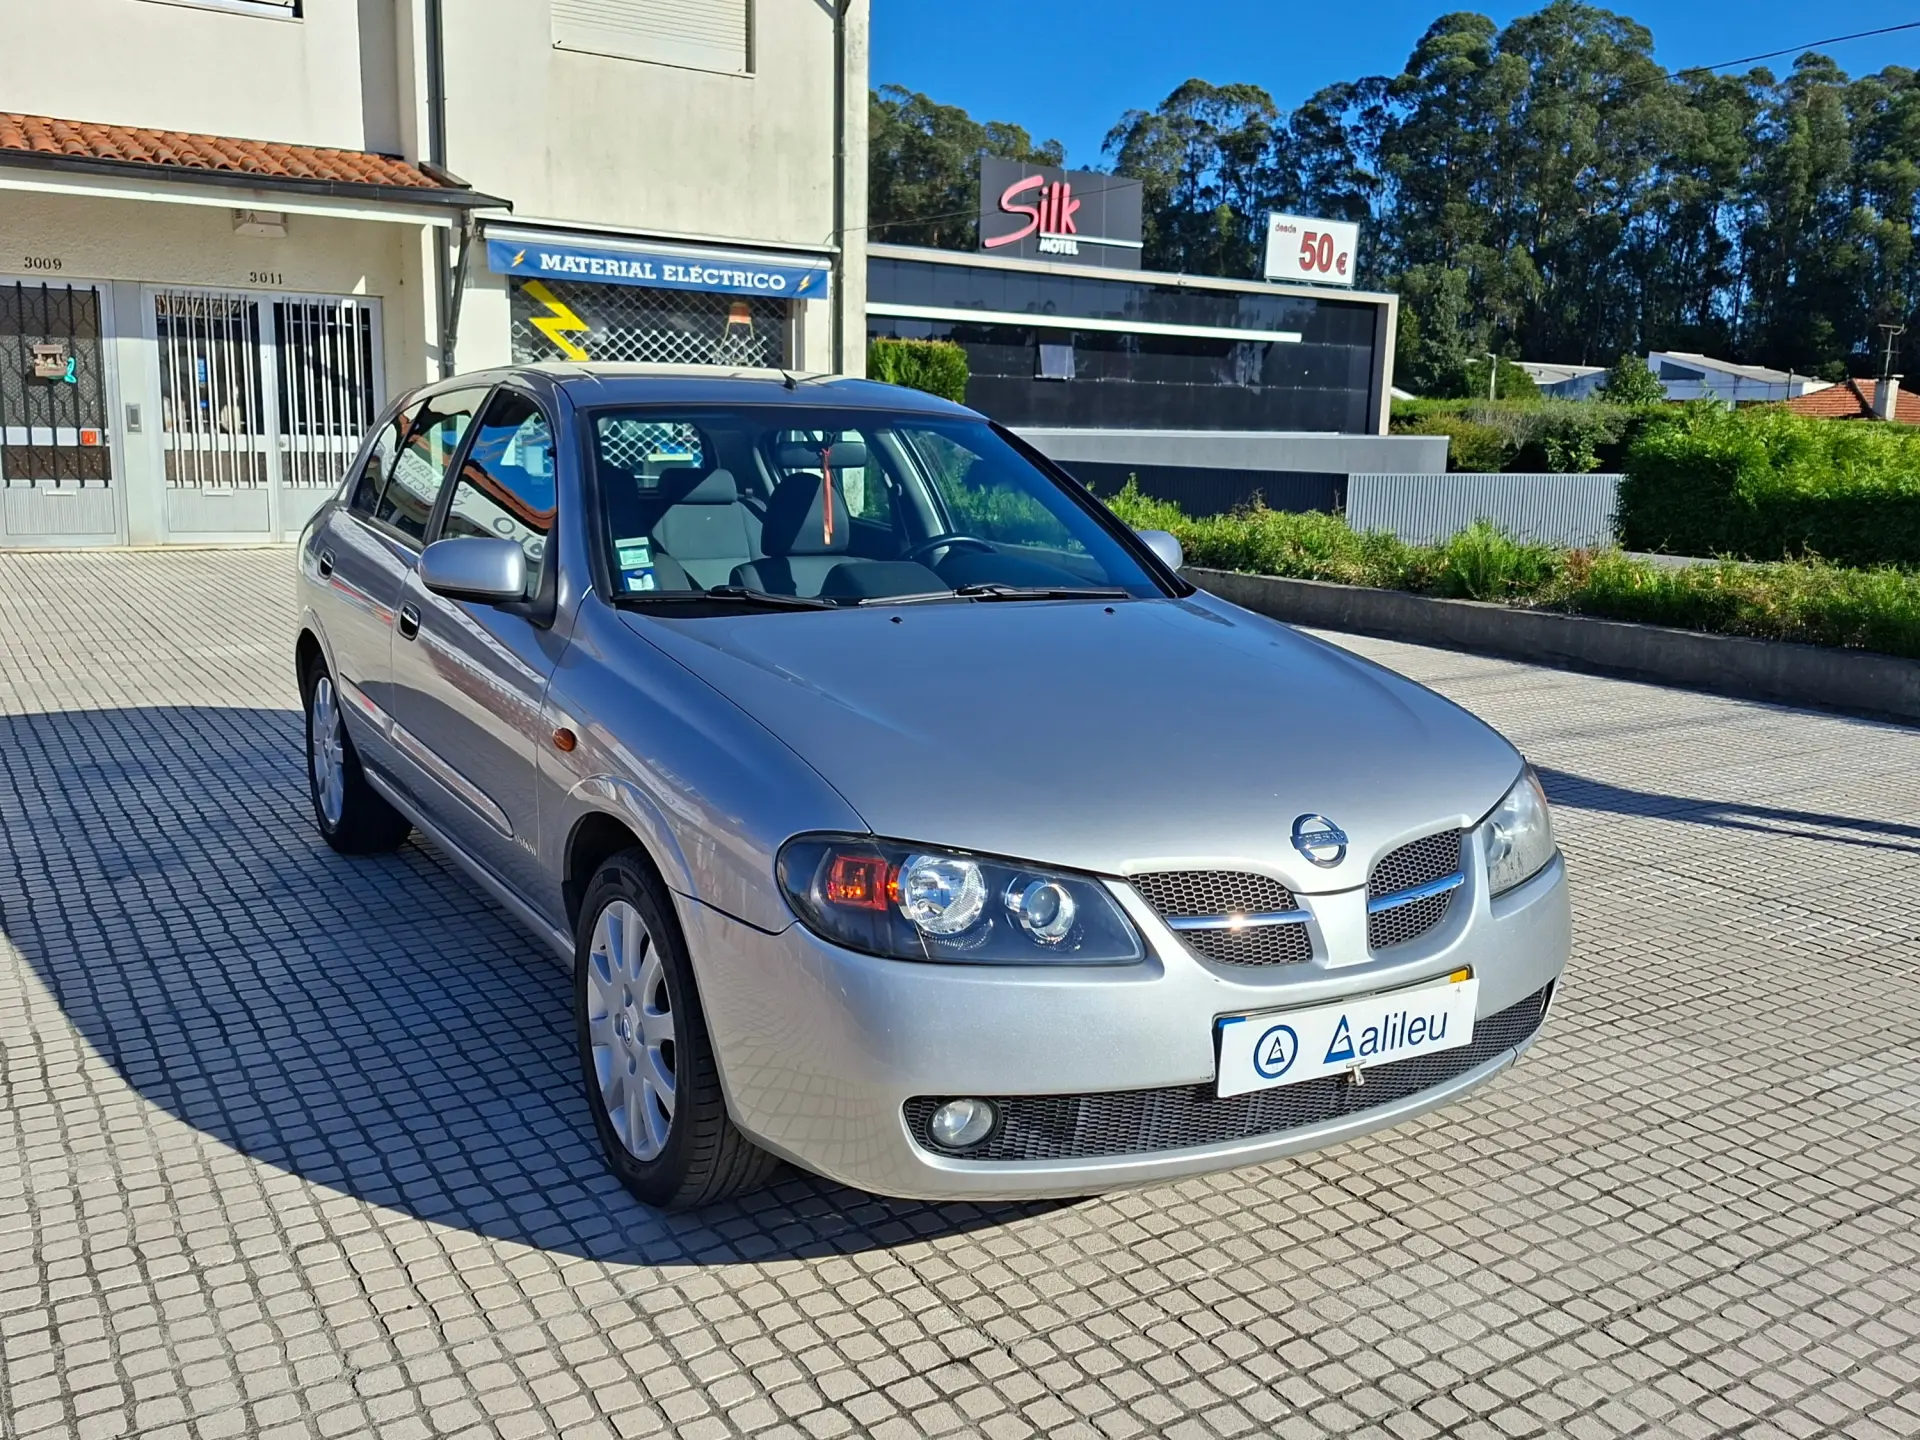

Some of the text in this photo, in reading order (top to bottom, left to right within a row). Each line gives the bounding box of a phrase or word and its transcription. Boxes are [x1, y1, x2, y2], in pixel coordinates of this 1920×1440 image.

[984, 175, 1081, 248] Silk
[1039, 238, 1079, 255] MOTEL
[1298, 231, 1348, 275] 50 €
[24, 256, 62, 270] 3009
[540, 253, 657, 280] MATERIAL
[249, 271, 283, 285] 3011
